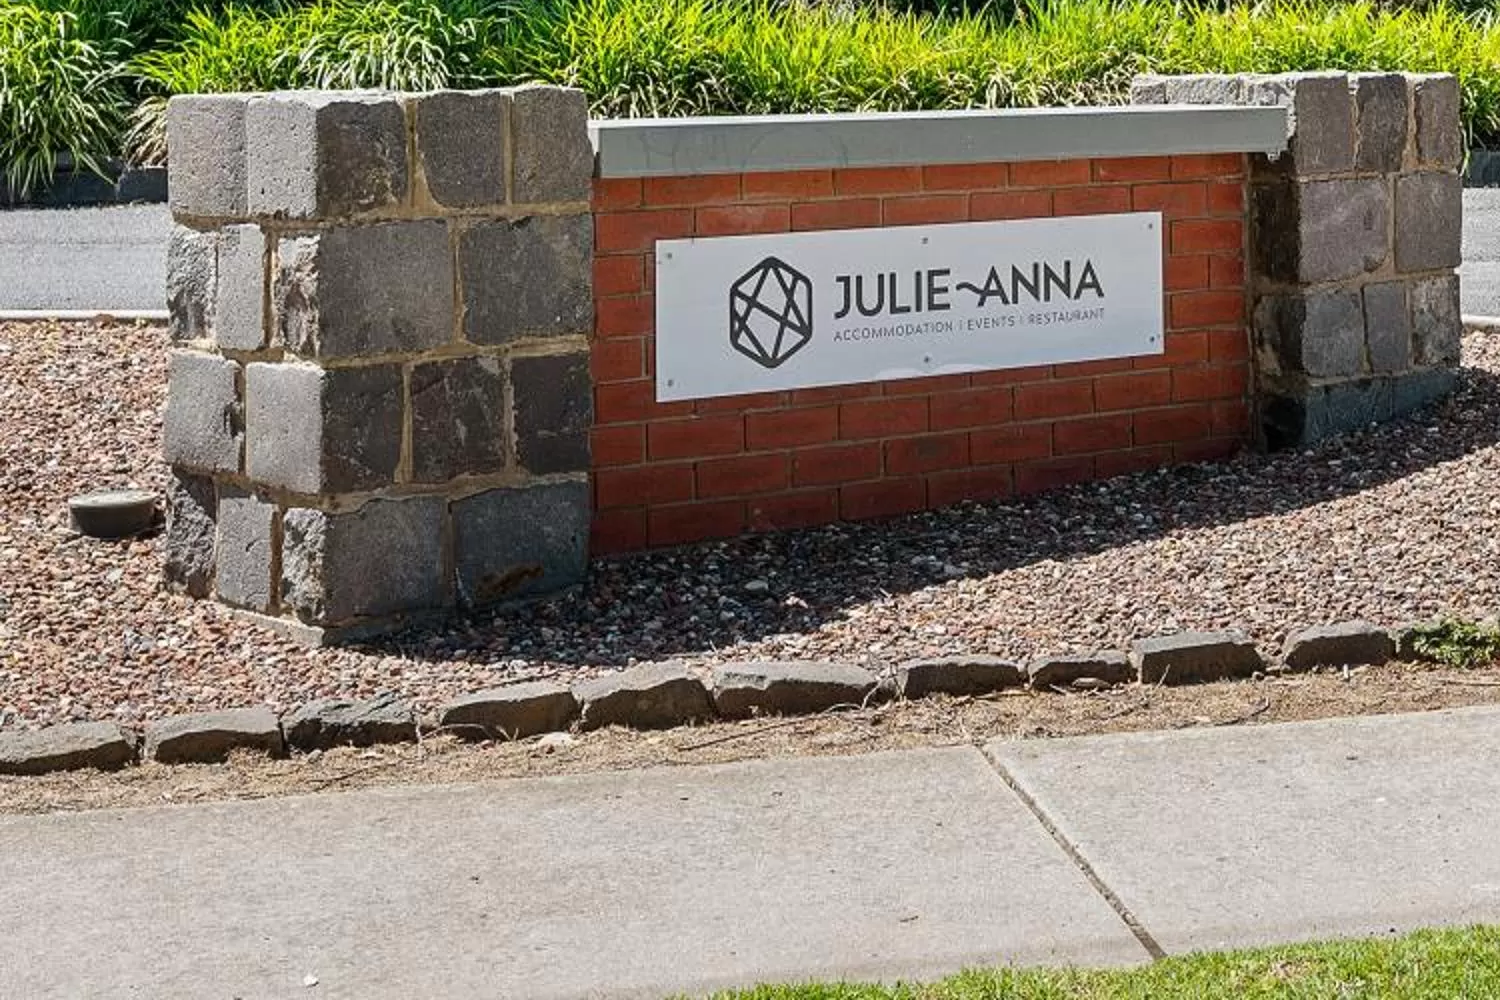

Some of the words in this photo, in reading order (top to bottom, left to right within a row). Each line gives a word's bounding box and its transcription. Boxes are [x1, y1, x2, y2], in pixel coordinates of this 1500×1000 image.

[833, 321, 954, 342] ACCOMMODATION
[966, 314, 1016, 331] EVENTS
[1027, 308, 1105, 326] RESTAURANT
